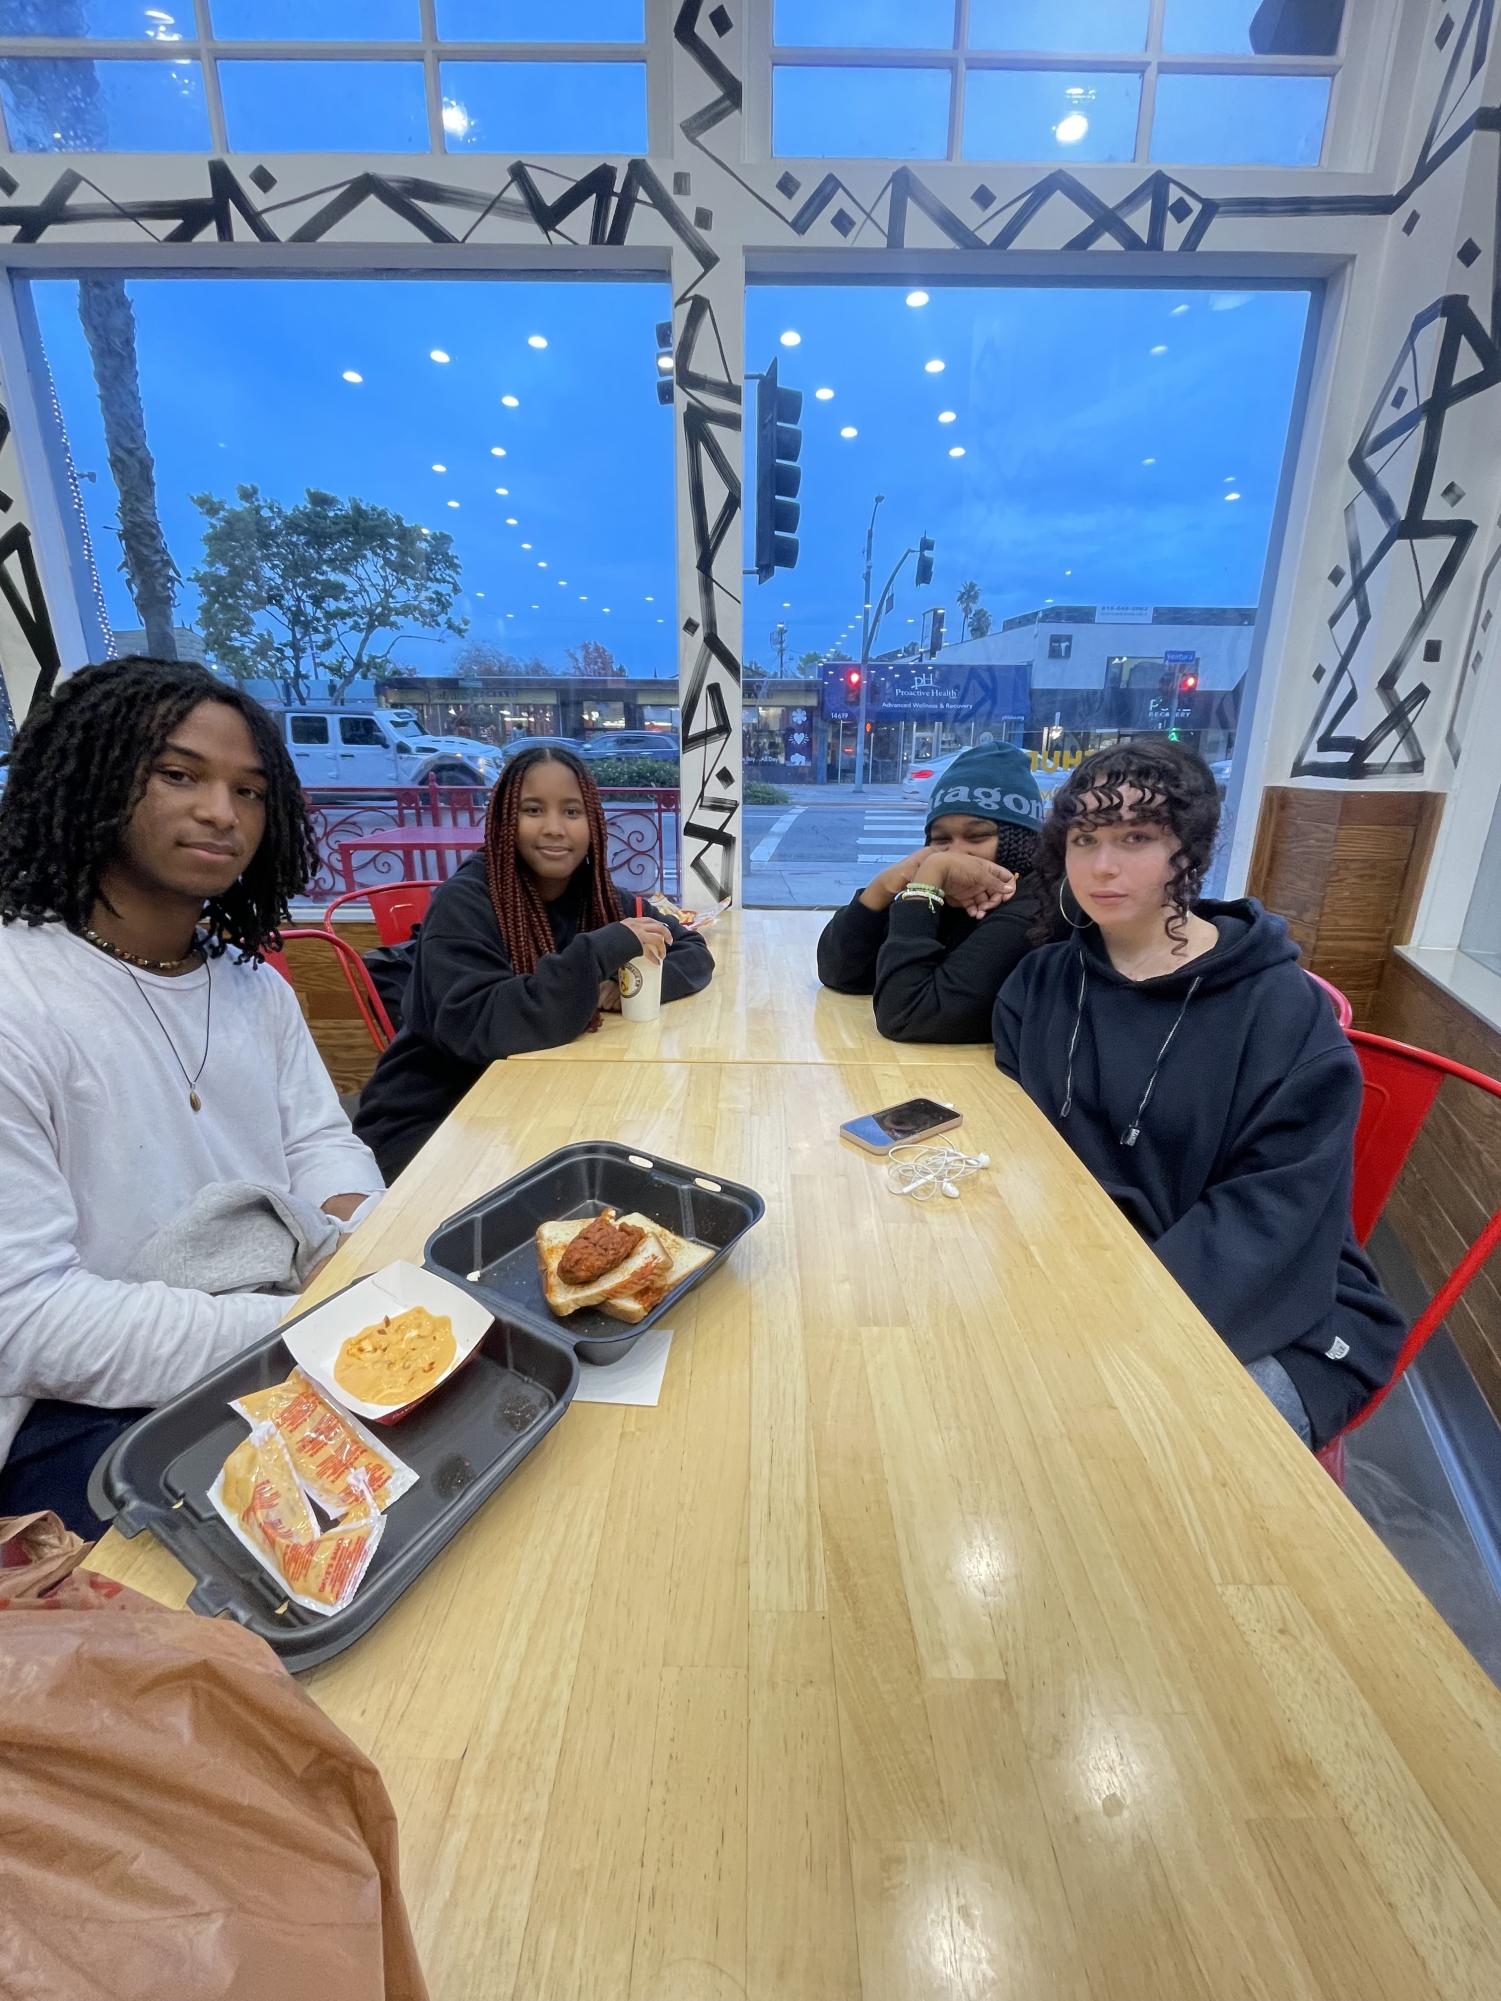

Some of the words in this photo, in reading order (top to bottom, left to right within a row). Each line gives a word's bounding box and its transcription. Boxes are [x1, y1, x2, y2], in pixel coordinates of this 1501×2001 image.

[895, 688, 930, 697] Proactive
[931, 688, 957, 697] Health
[929, 785, 1043, 821] tagon
